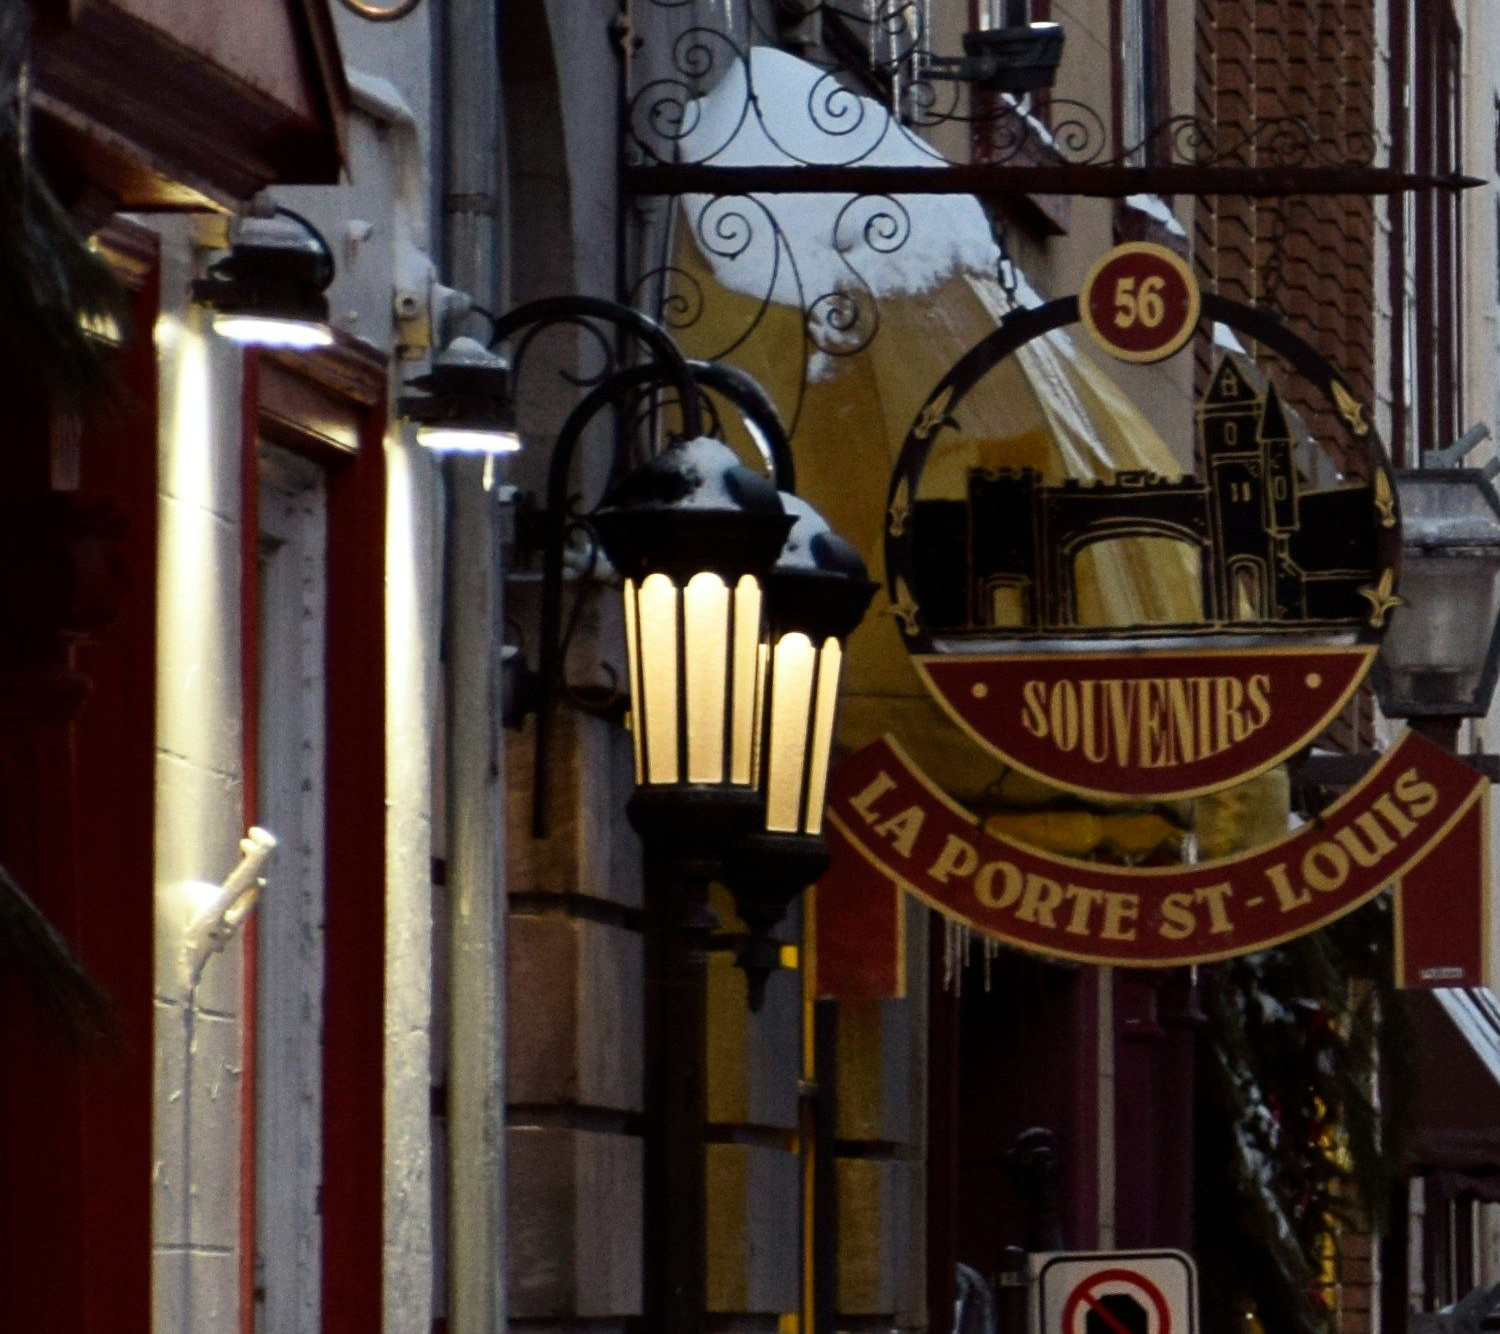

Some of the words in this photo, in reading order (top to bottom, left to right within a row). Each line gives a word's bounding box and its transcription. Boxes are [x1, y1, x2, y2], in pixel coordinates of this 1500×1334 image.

[1113, 275, 1165, 329] 56
[1020, 673, 1272, 768] SOUVENIRS
[848, 770, 926, 858] LA
[927, 832, 1142, 941] PORTE
